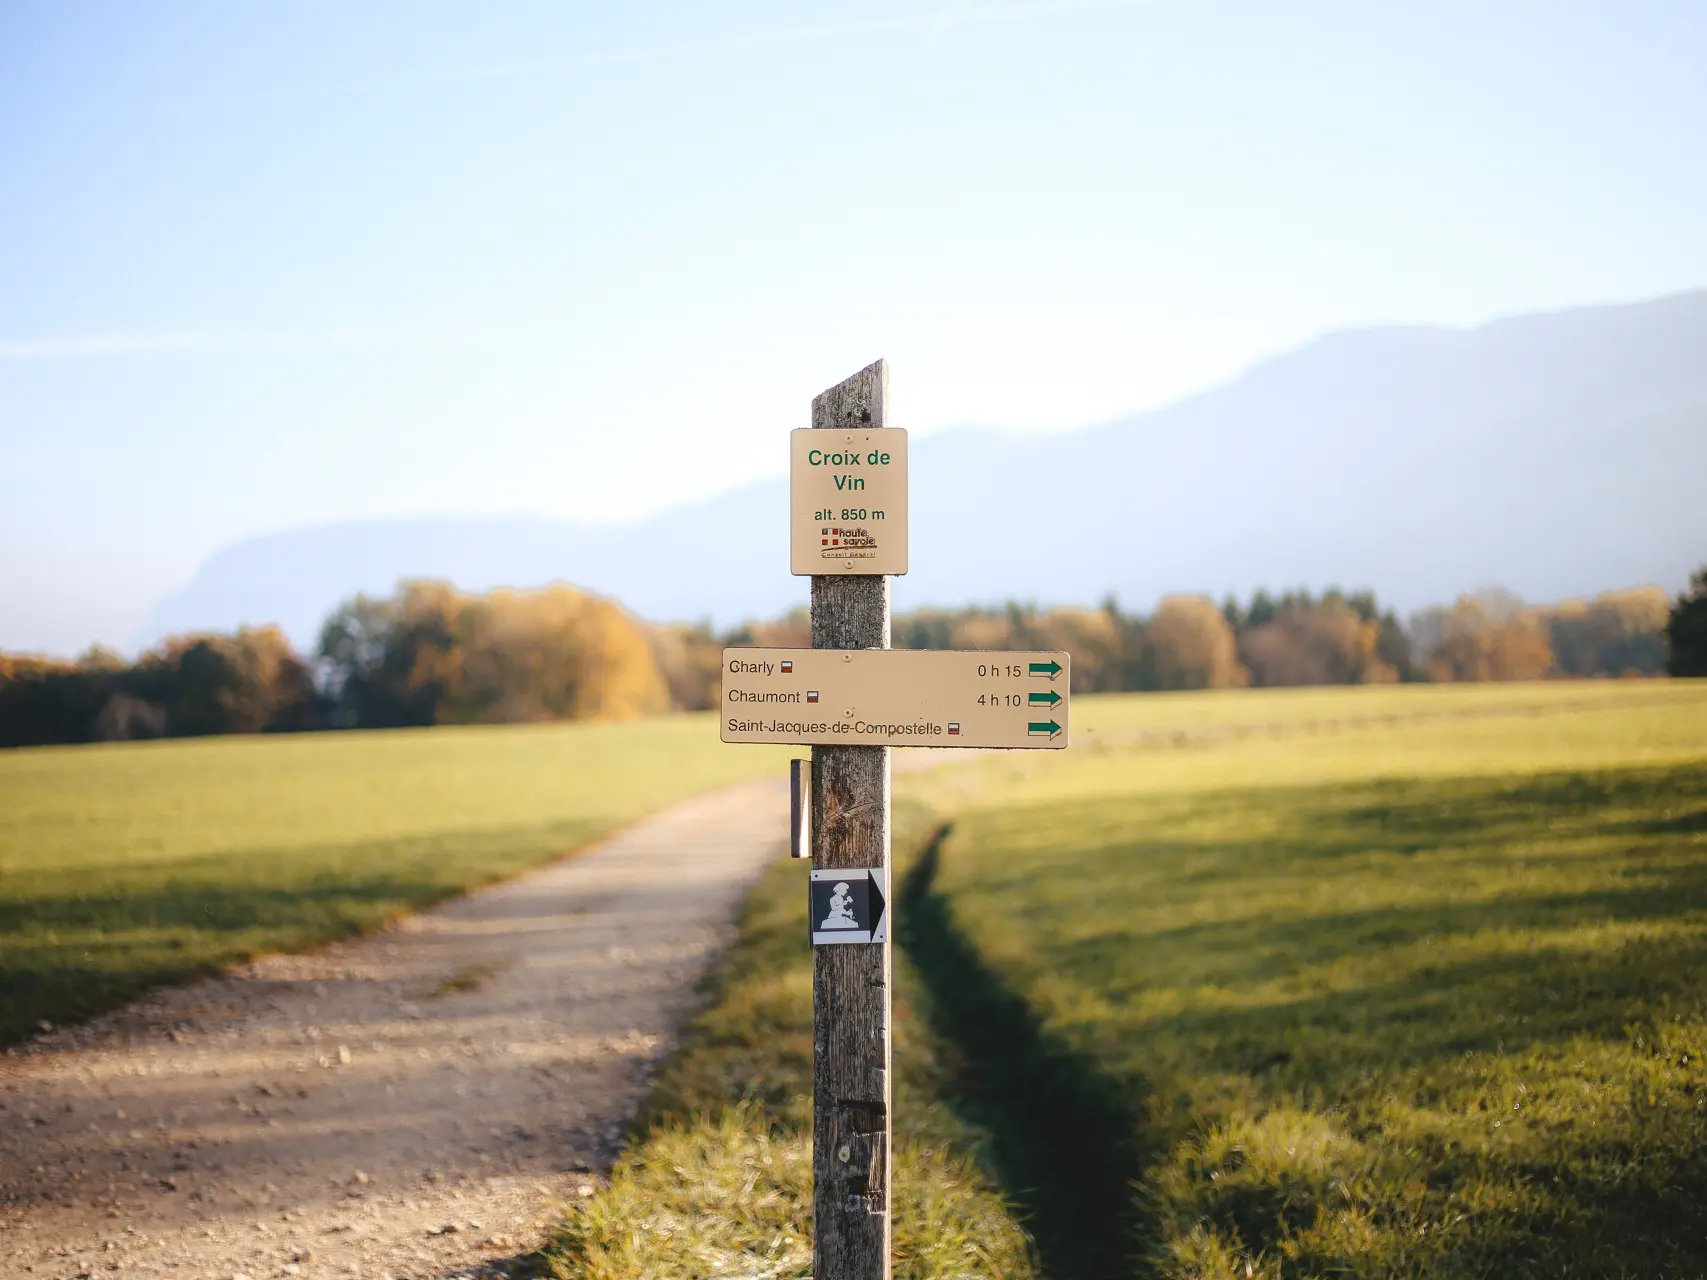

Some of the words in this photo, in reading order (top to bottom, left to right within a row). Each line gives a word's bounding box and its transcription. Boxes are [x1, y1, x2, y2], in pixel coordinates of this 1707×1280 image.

[808, 450, 861, 466] Croix
[867, 449, 891, 466] de
[833, 475, 865, 491] Vin
[814, 508, 836, 521] alt.
[841, 508, 867, 521] 850
[871, 510, 885, 520] m
[839, 527, 867, 538] haute
[843, 536, 875, 546] savoie
[729, 660, 775, 676] Charly
[977, 664, 987, 677] 0
[991, 664, 1000, 677] h
[1005, 665, 1022, 677] 15
[728, 689, 801, 703] Chaumont
[976, 694, 986, 706] 4
[990, 694, 999, 706] h
[1005, 694, 1021, 707] 10
[728, 718, 942, 736] Saint-Jacques-de-Compostelle
